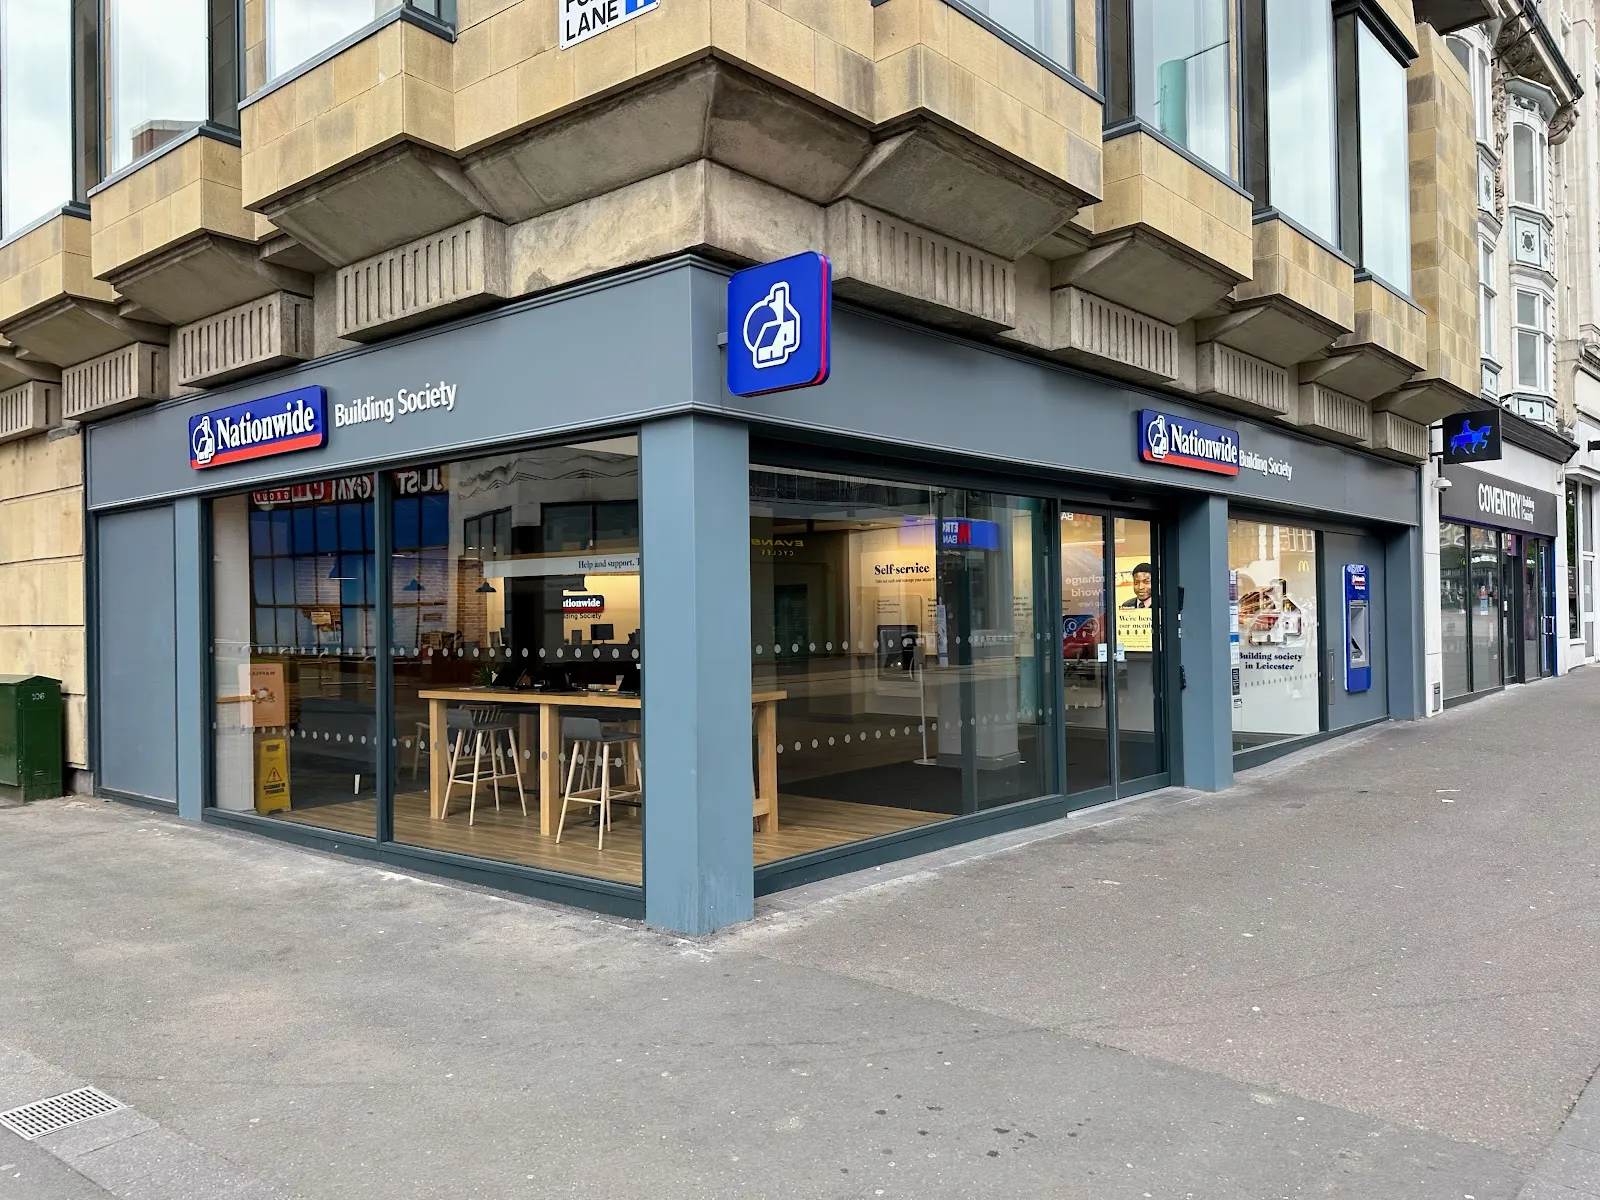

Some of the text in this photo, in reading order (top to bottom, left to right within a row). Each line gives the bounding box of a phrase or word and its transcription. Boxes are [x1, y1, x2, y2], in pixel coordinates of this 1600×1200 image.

[566, 0, 619, 41] LANE
[335, 381, 457, 428] Building Society
[216, 400, 315, 450] Nationwide
[1170, 423, 1238, 464] Nationwide
[1239, 449, 1293, 481] Building Society
[1478, 483, 1522, 520] COVENTRY
[578, 561, 593, 570] Help
[594, 560, 607, 568] and
[607, 559, 635, 569] support.
[874, 562, 930, 576] Self-service
[579, 612, 602, 620] Society
[1240, 651, 1272, 661] Building
[1274, 652, 1303, 662] society
[1245, 661, 1294, 670] in Leicester
